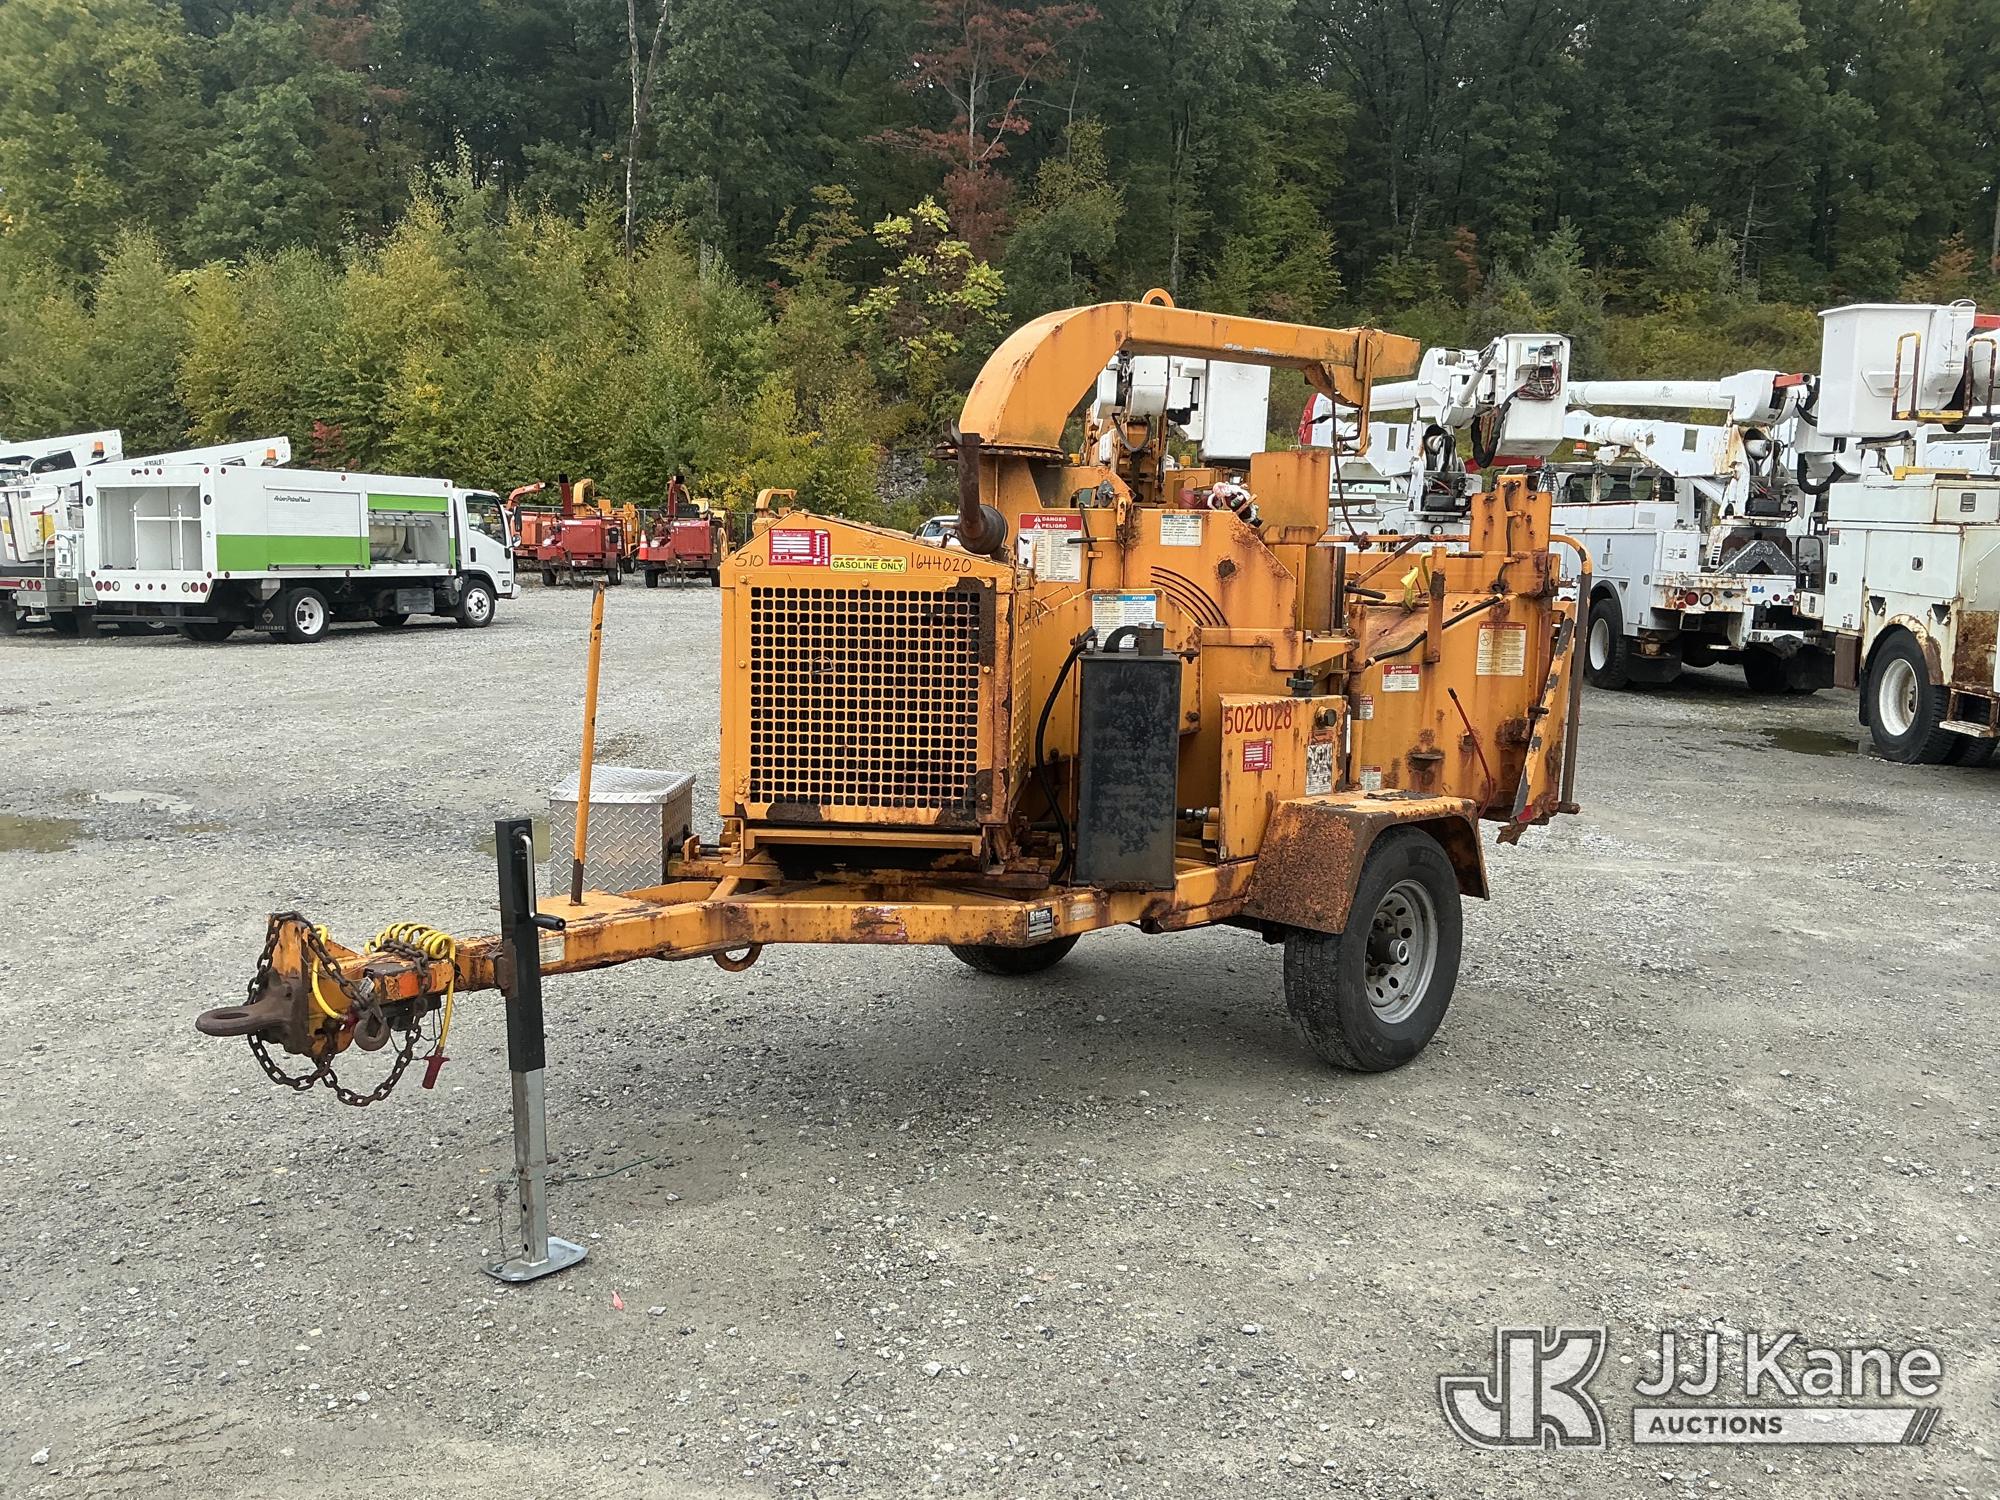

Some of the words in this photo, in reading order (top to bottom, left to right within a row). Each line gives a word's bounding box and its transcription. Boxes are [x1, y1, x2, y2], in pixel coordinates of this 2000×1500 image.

[734, 552, 764, 568] 510
[832, 561, 878, 570] GASOLINE
[880, 562, 904, 571] ONLY
[911, 552, 972, 573] 1644020
[1751, 585, 1765, 594] B4
[1224, 701, 1292, 735] 5020028
